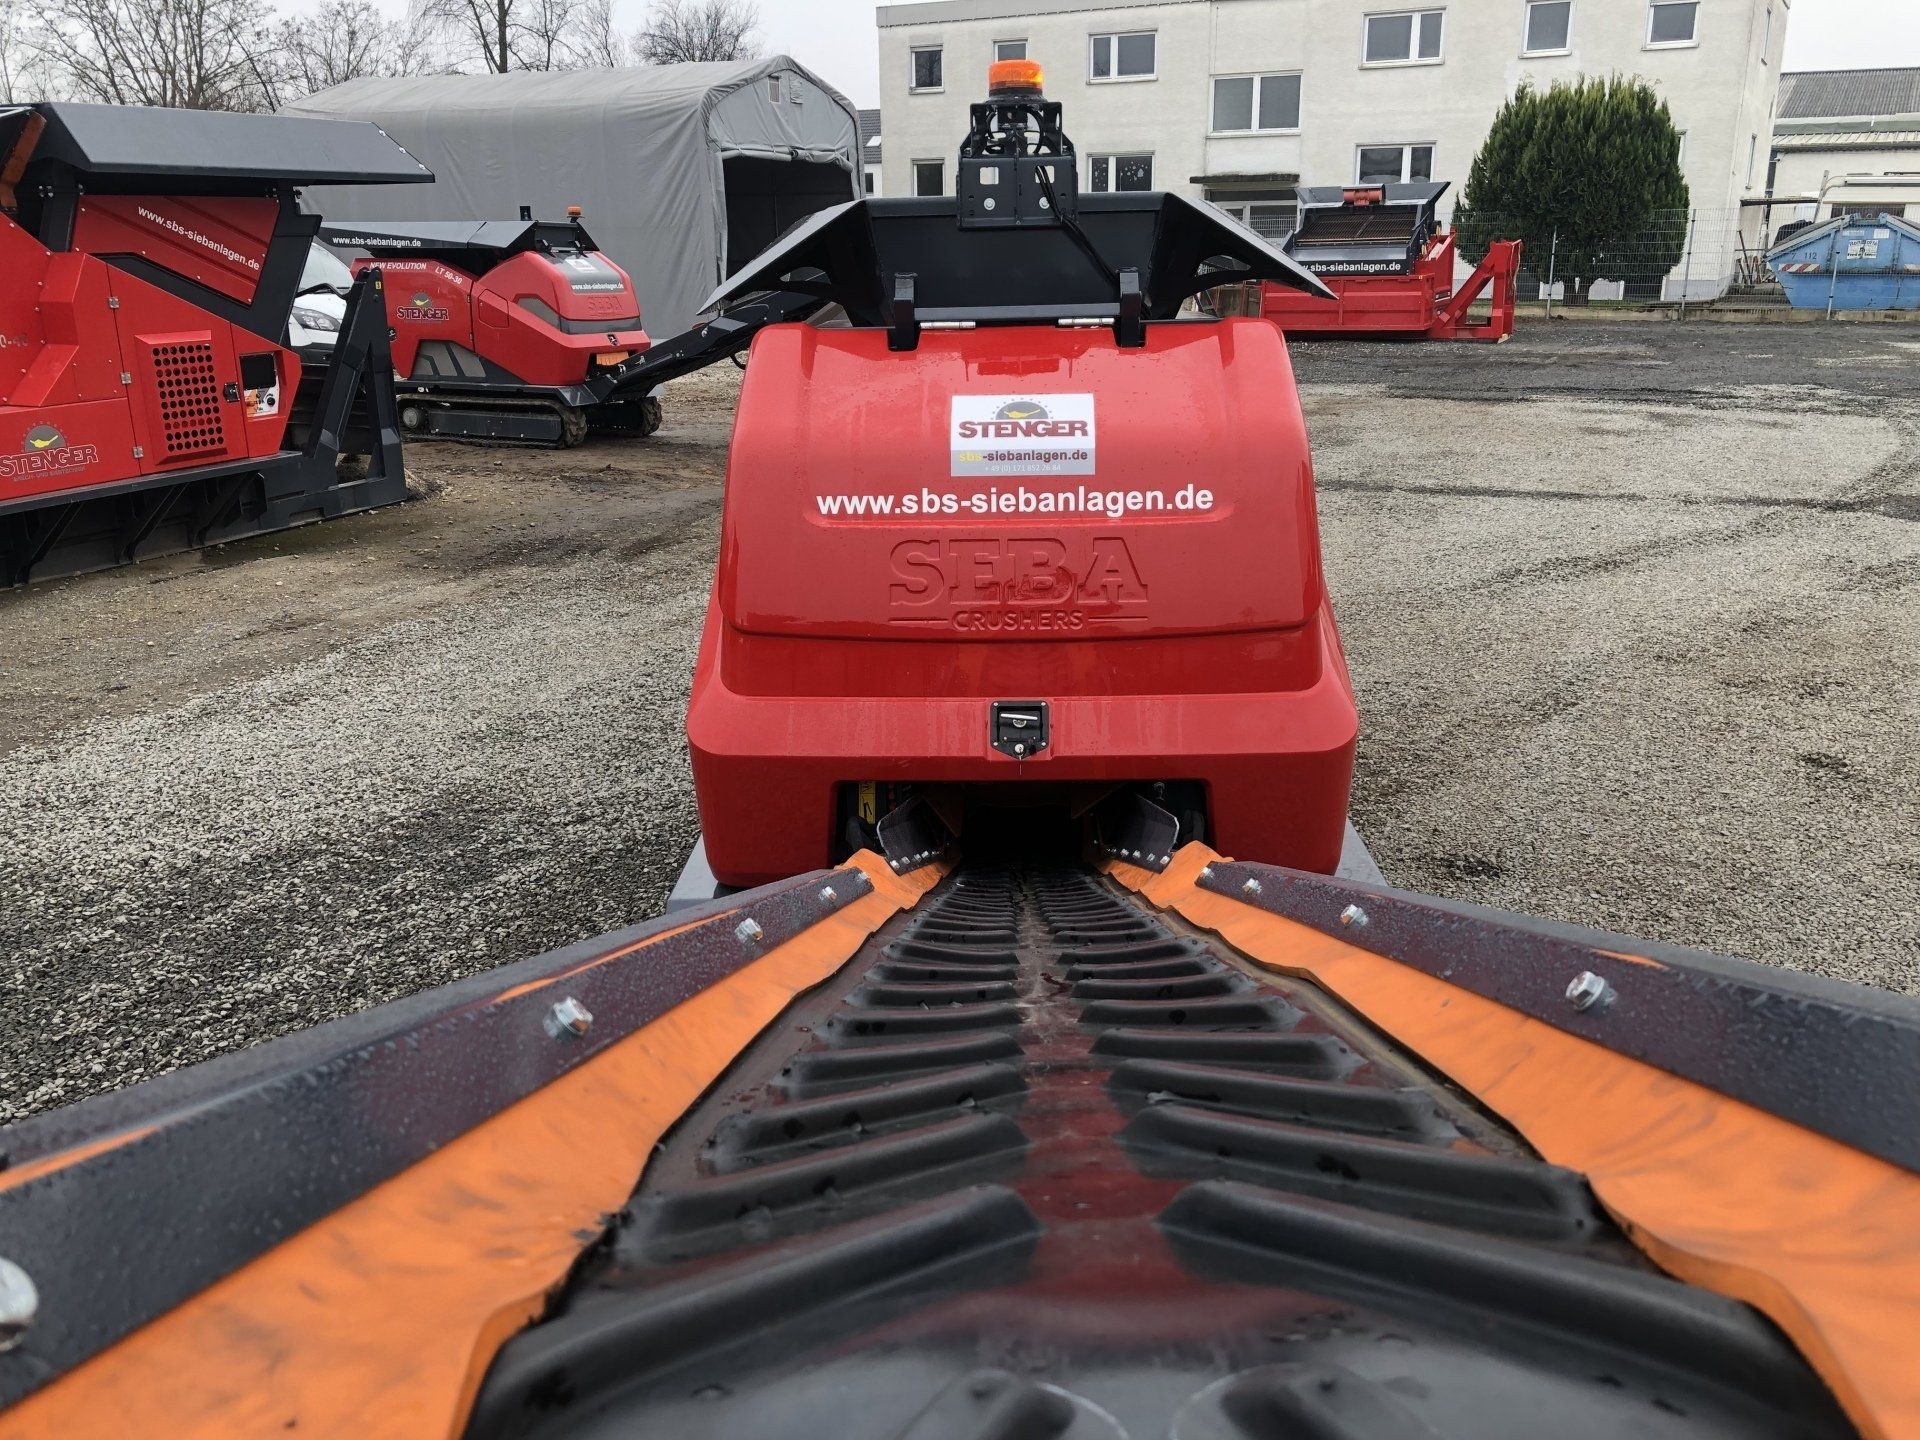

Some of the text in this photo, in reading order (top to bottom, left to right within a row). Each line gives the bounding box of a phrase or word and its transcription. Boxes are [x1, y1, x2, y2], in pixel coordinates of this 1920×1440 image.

[137, 206, 260, 271] www.sbs-siebanlagen.de
[332, 236, 422, 249] www.sbs-siebanlagen.de
[387, 262, 427, 270] EVOLUTION
[435, 266, 463, 285] LT 50-30
[396, 306, 450, 320] STENGER
[958, 420, 1088, 439] STENGER
[0, 444, 99, 477] STENGER
[959, 450, 1088, 463] sbs-siebanlagen.de
[816, 484, 1214, 517] www.sbs-siebanlagen.de
[890, 537, 1148, 606] SEBA
[951, 610, 1084, 631] CRUSHERS
